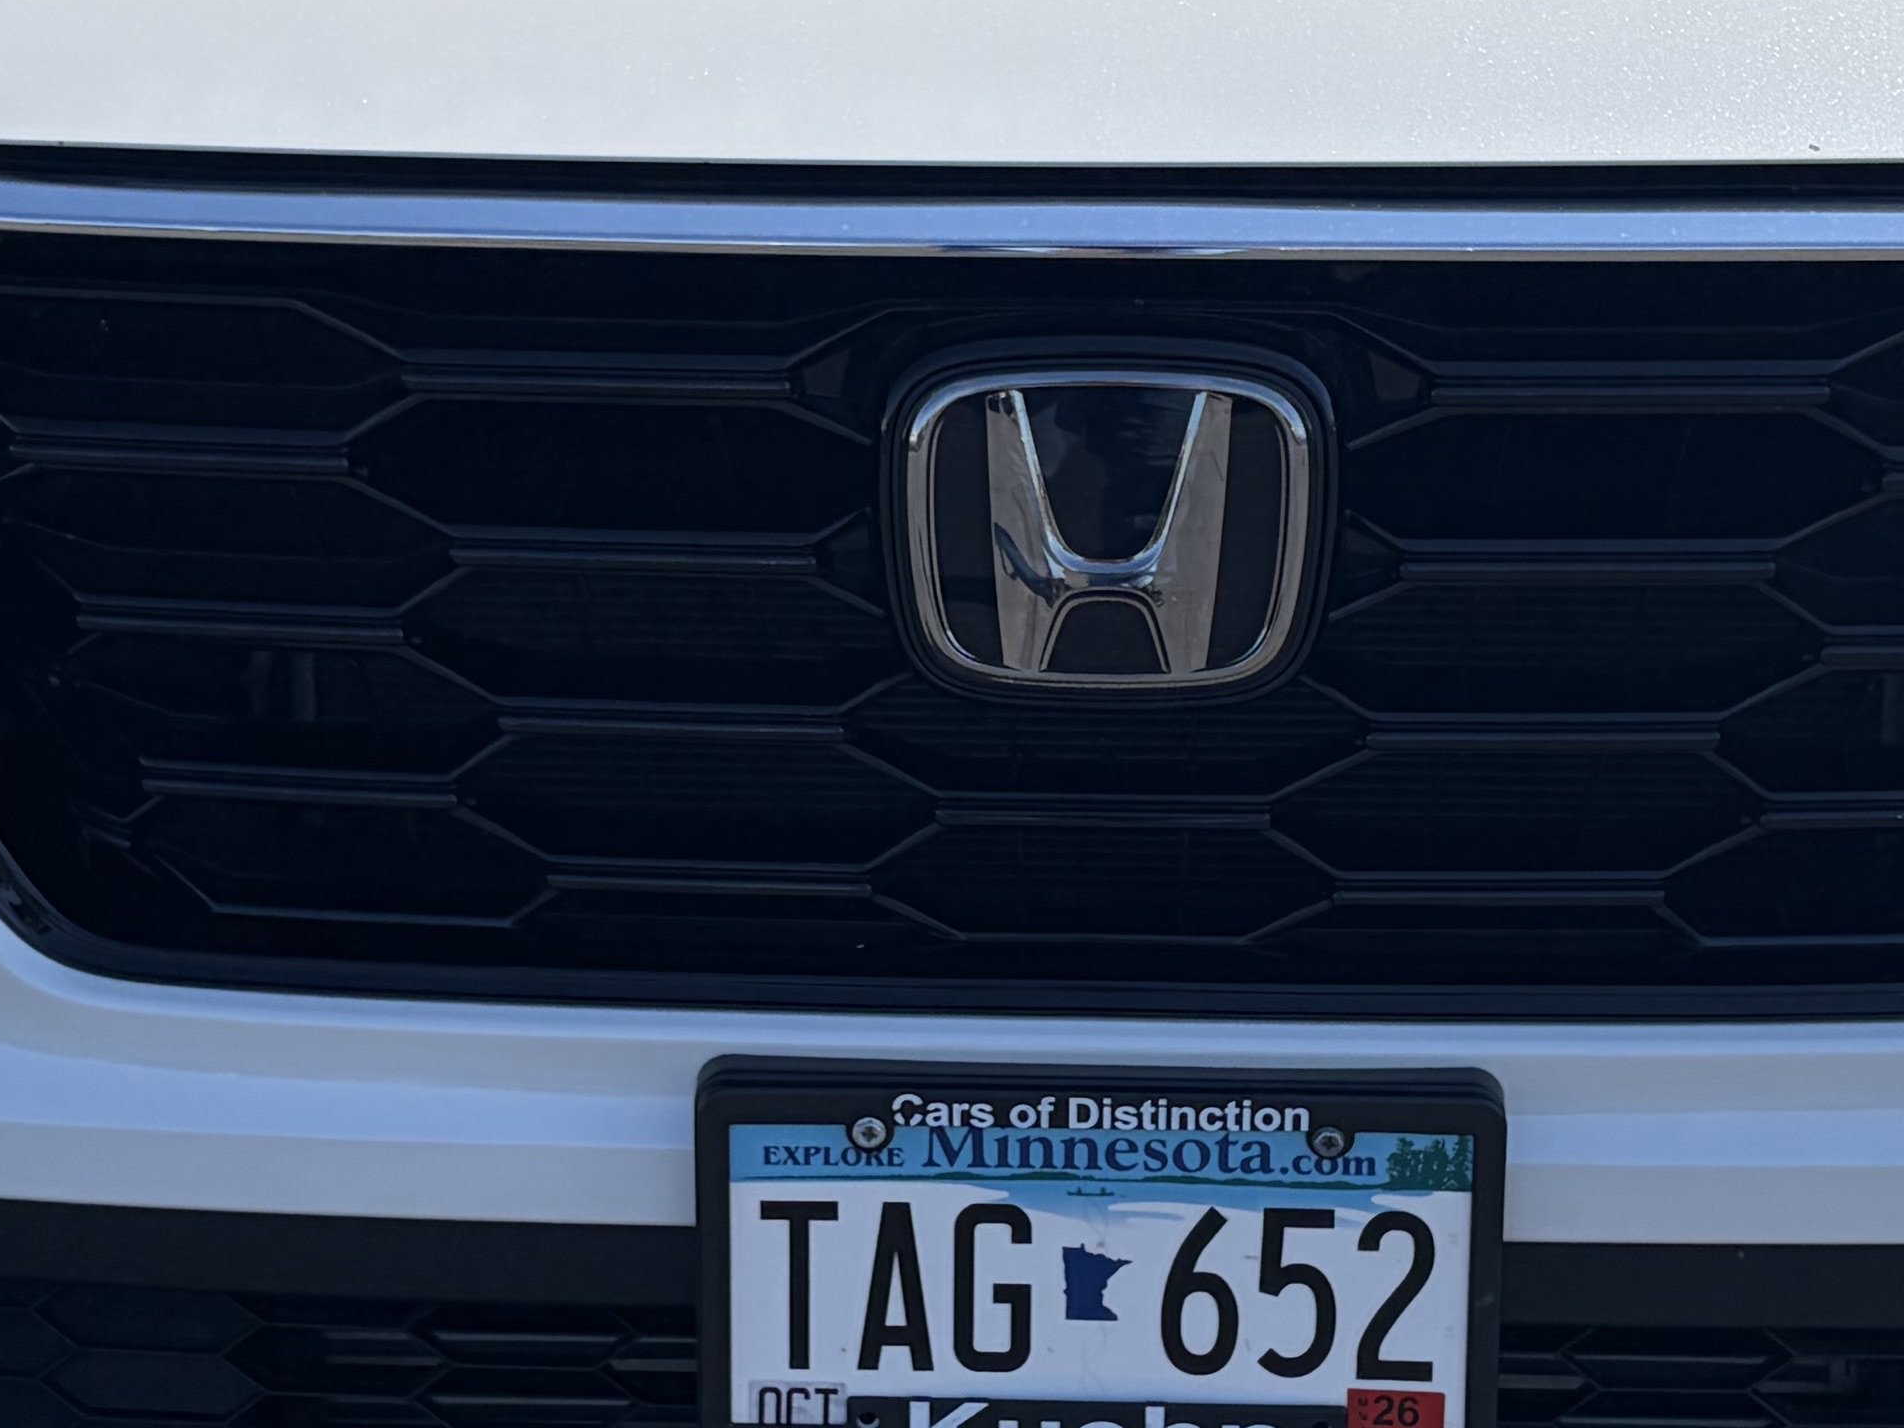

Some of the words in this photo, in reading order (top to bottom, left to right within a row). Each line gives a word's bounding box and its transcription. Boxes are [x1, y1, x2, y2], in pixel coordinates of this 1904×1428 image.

[891, 1093, 995, 1128] Cars
[1009, 1096, 1056, 1129] of
[1068, 1096, 1310, 1132] Distinction
[763, 1145, 906, 1167] EXPLORE
[760, 1200, 1033, 1372] TAG
[1161, 1206, 1435, 1382] 652
[1372, 1394, 1420, 1427] 26
